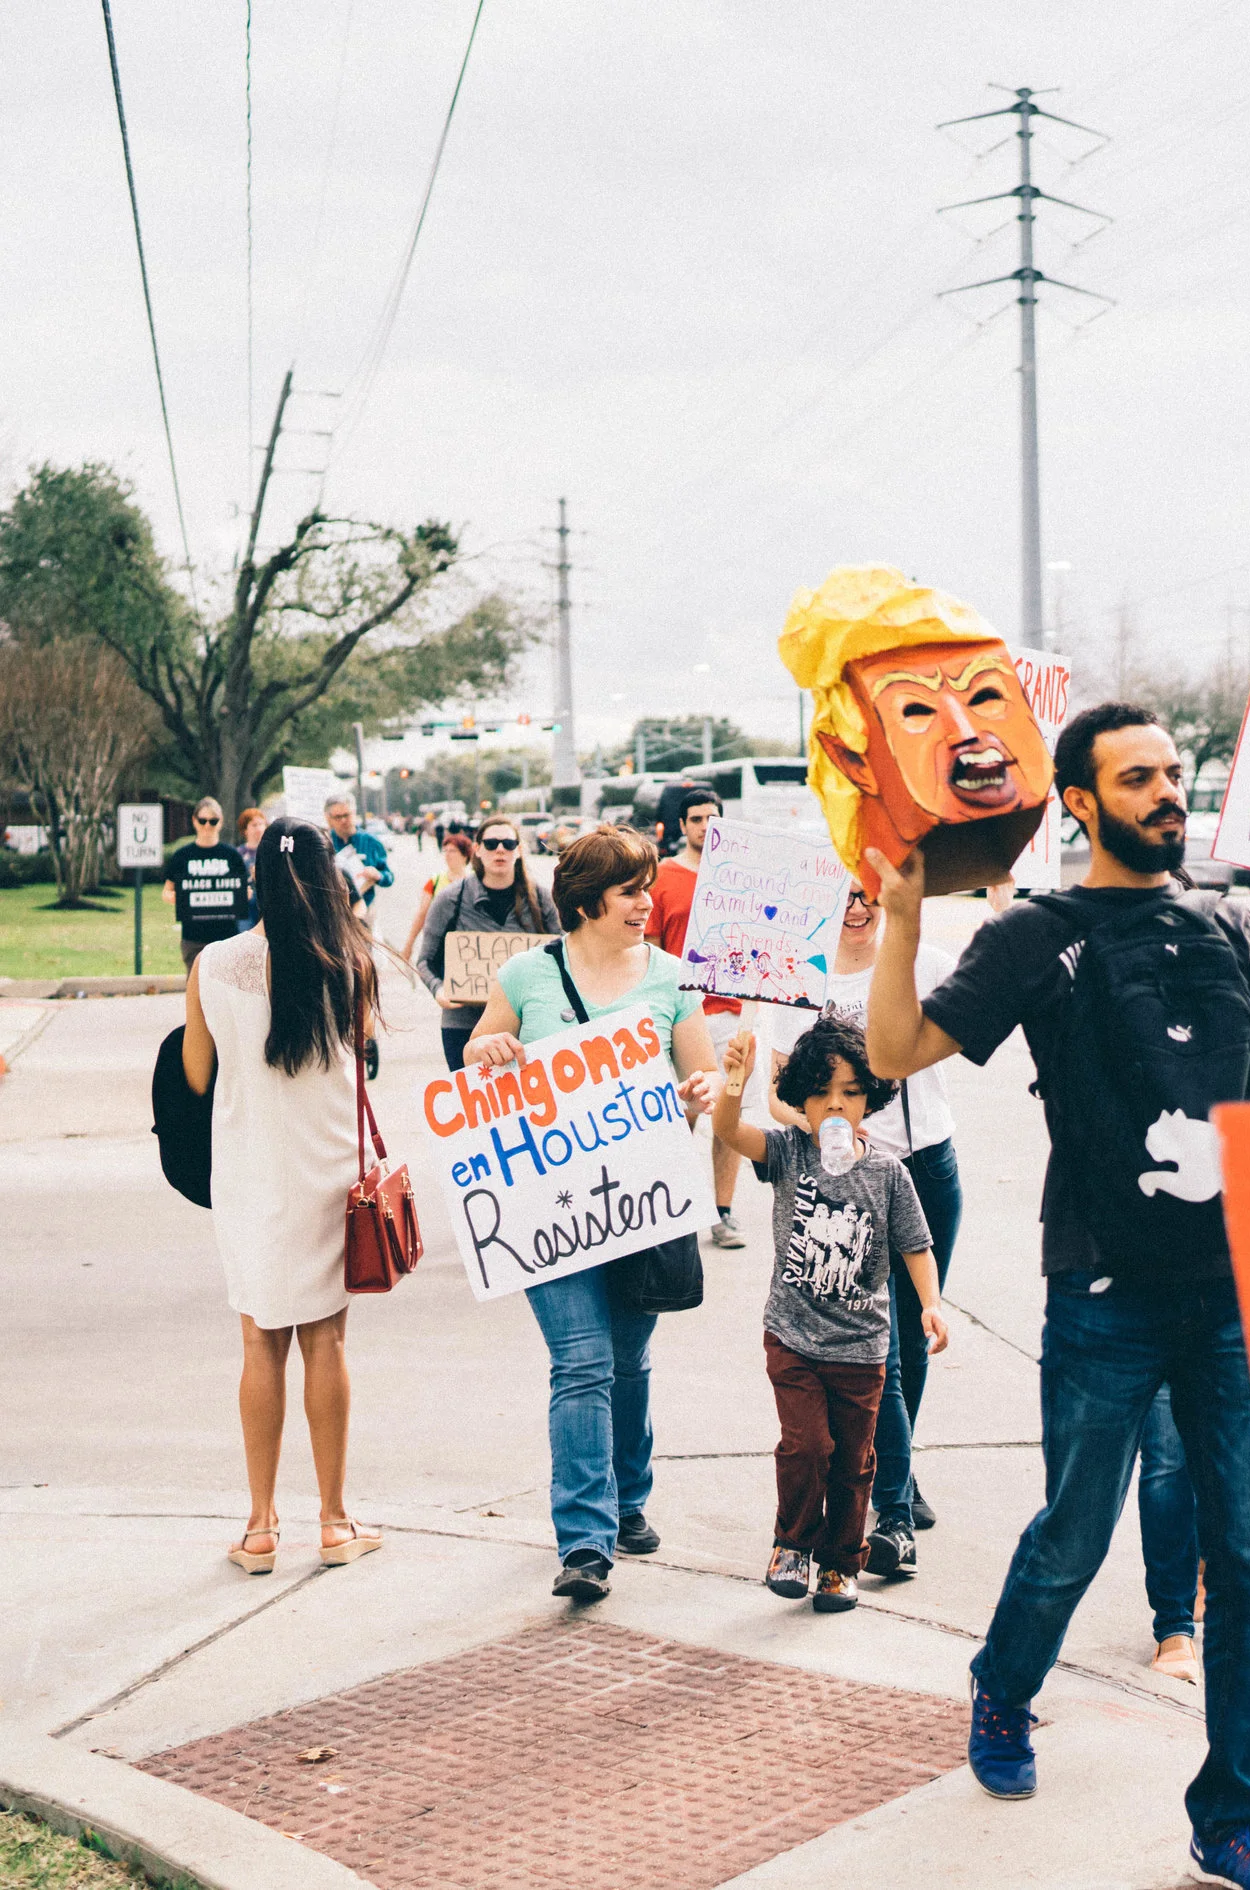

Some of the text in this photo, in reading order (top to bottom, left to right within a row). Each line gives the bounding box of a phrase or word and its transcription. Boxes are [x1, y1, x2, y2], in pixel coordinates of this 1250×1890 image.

[1015, 657, 1070, 726] RANTS
[132, 812, 149, 823] NO
[134, 826, 147, 843] U
[126, 846, 156, 858] TURN
[182, 878, 241, 890] BLACK LIVES
[719, 869, 789, 895] around
[703, 891, 808, 926] family and
[424, 1017, 661, 1137] Chingonas
[452, 1081, 685, 1187] en Houston
[463, 1165, 692, 1289] Resisten
[782, 1173, 818, 1287] STAR WARS
